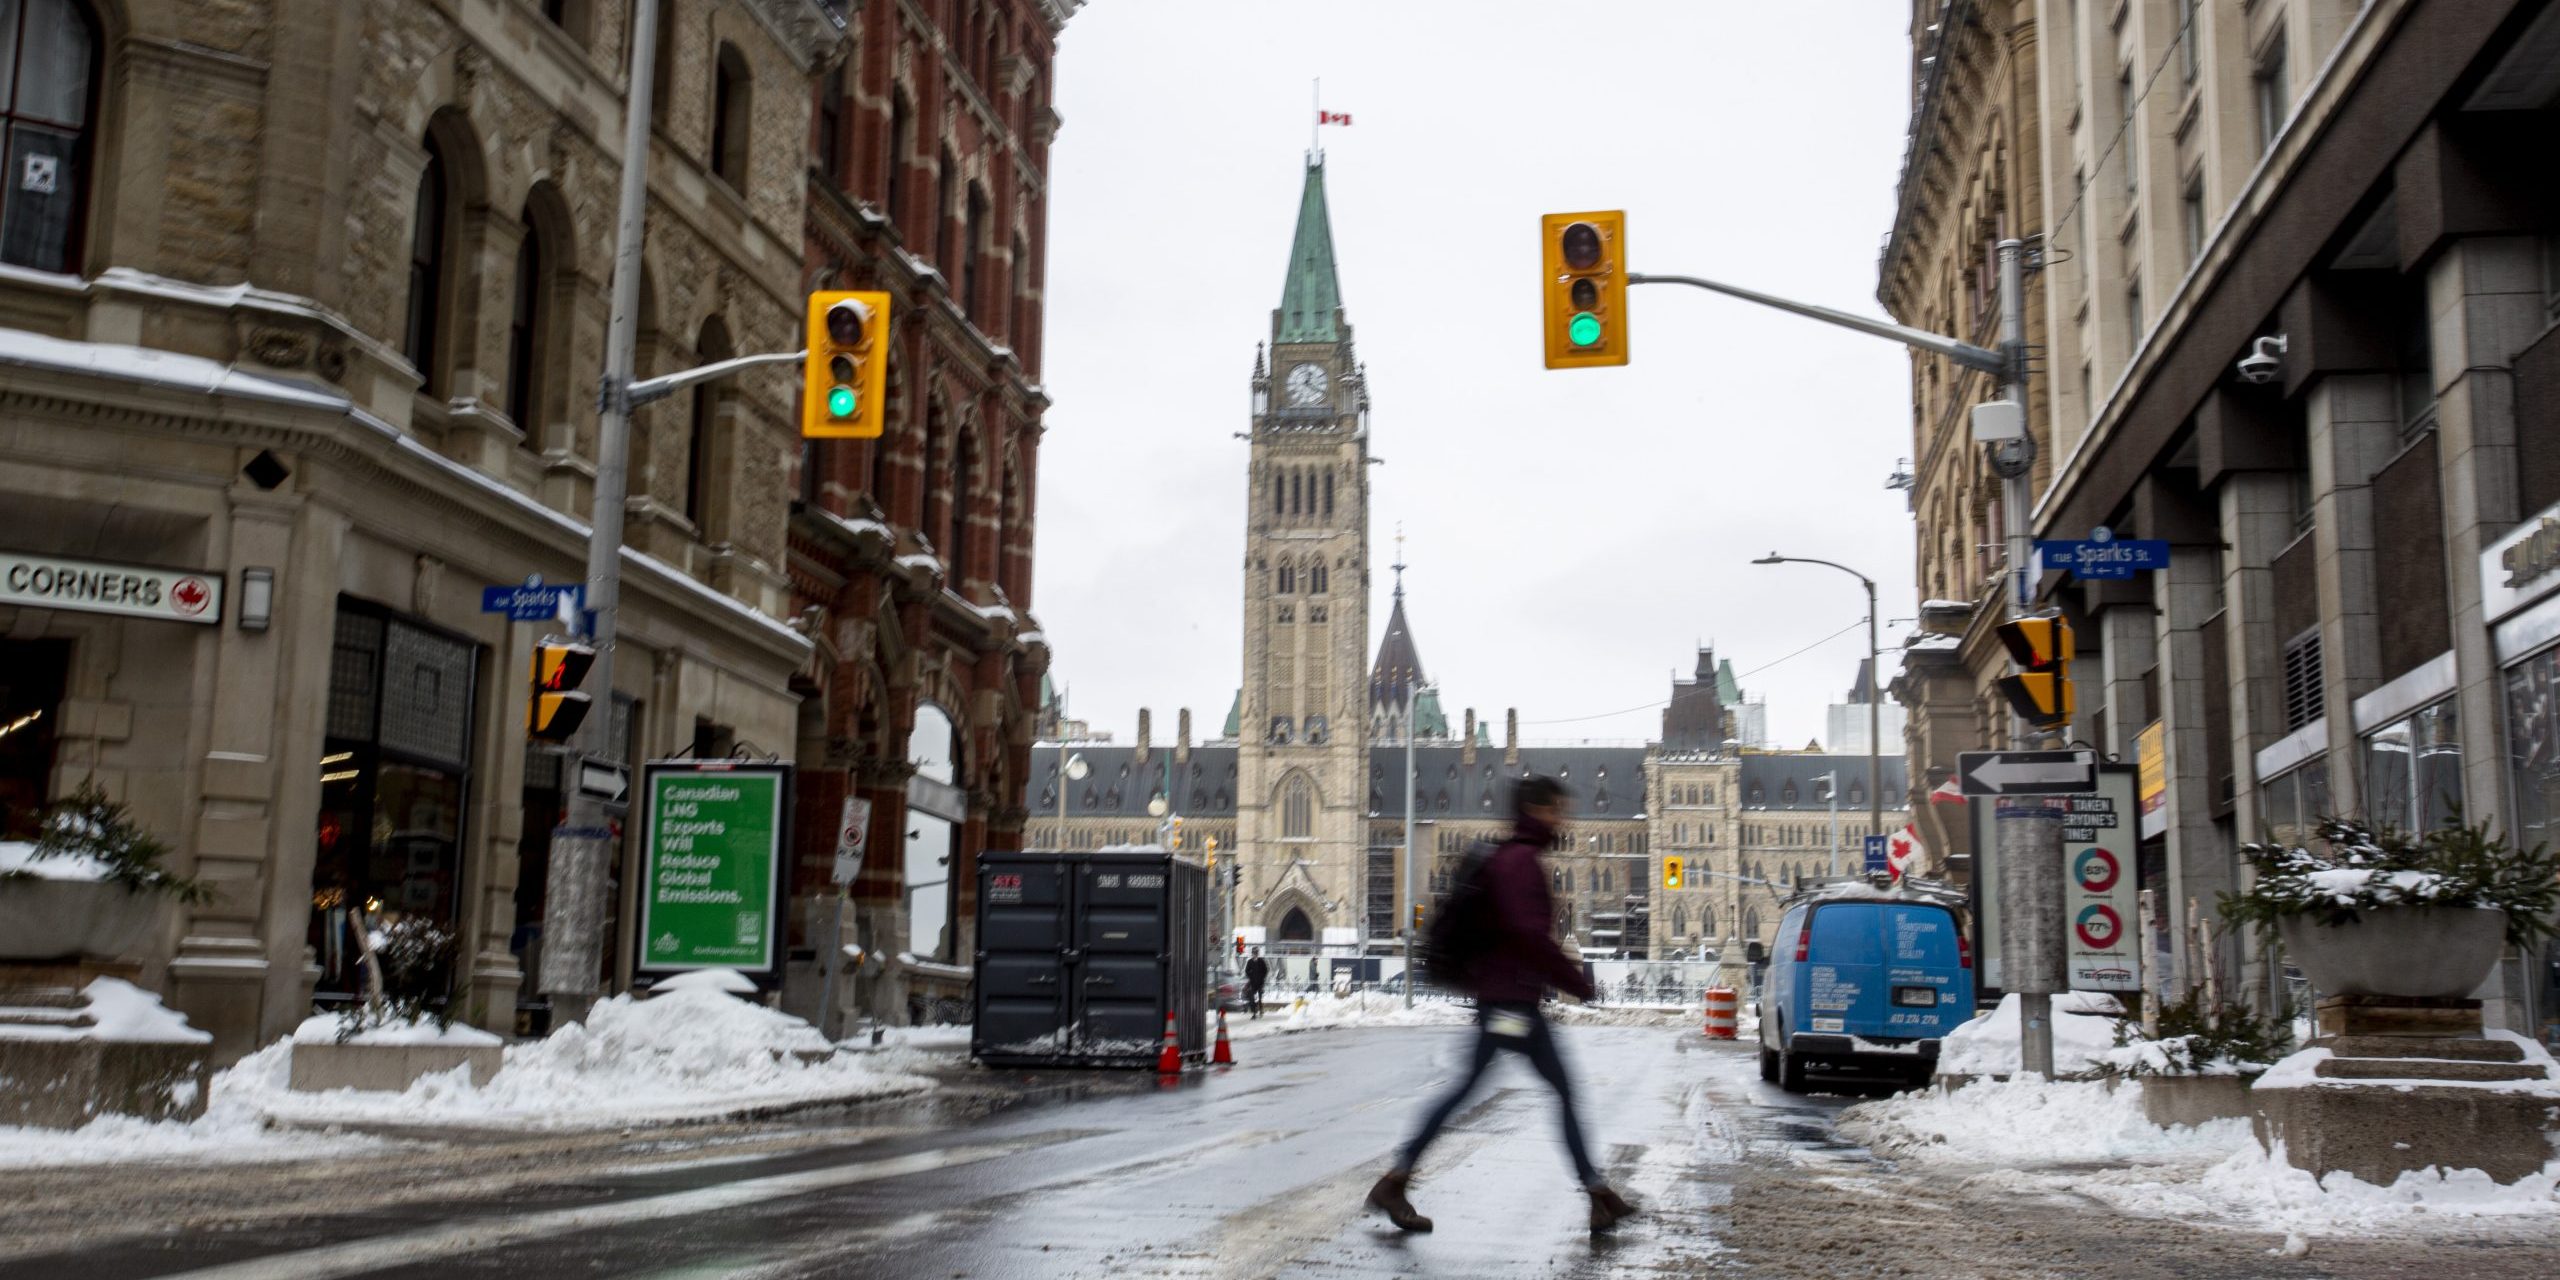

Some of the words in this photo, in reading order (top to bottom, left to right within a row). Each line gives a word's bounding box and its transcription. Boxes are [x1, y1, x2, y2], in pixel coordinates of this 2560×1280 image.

[2052, 551, 2072, 562] rue
[2075, 543, 2132, 566] Sparks
[8, 562, 163, 607] CORNERS
[512, 587, 556, 607] Sparks
[664, 785, 740, 801] Canadian
[663, 802, 698, 818] LNG
[2073, 799, 2110, 811] TAKEN
[662, 819, 725, 835] Exports
[2063, 813, 2116, 826] ERYONE'S
[661, 835, 693, 851] Will
[1867, 840, 1883, 856] H
[660, 854, 720, 869] Reduce
[659, 870, 712, 885] Global
[2085, 865, 2109, 875] 63%
[658, 888, 742, 903] Emissions.
[2088, 922, 2111, 932] 77%
[2078, 971, 2132, 981] Taxpayers
